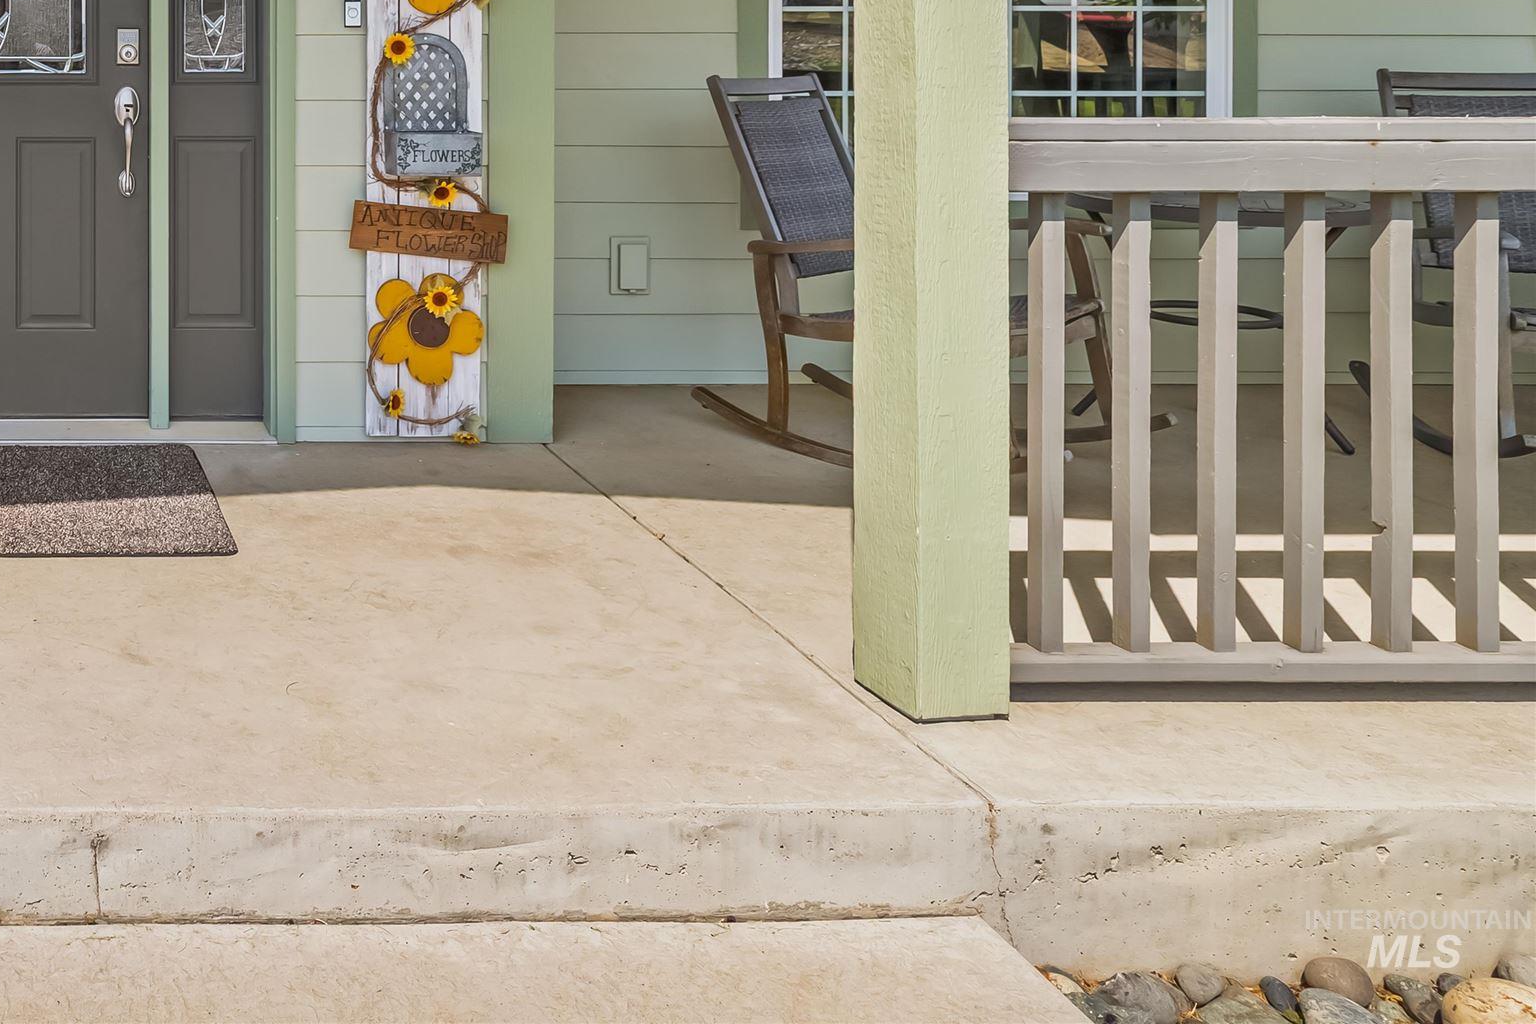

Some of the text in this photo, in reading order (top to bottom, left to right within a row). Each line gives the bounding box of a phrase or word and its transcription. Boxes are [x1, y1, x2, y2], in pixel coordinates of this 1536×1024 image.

[412, 149, 471, 163] FLOWERS
[358, 205, 476, 232] ANTIQUE
[373, 229, 468, 254] FLOWER
